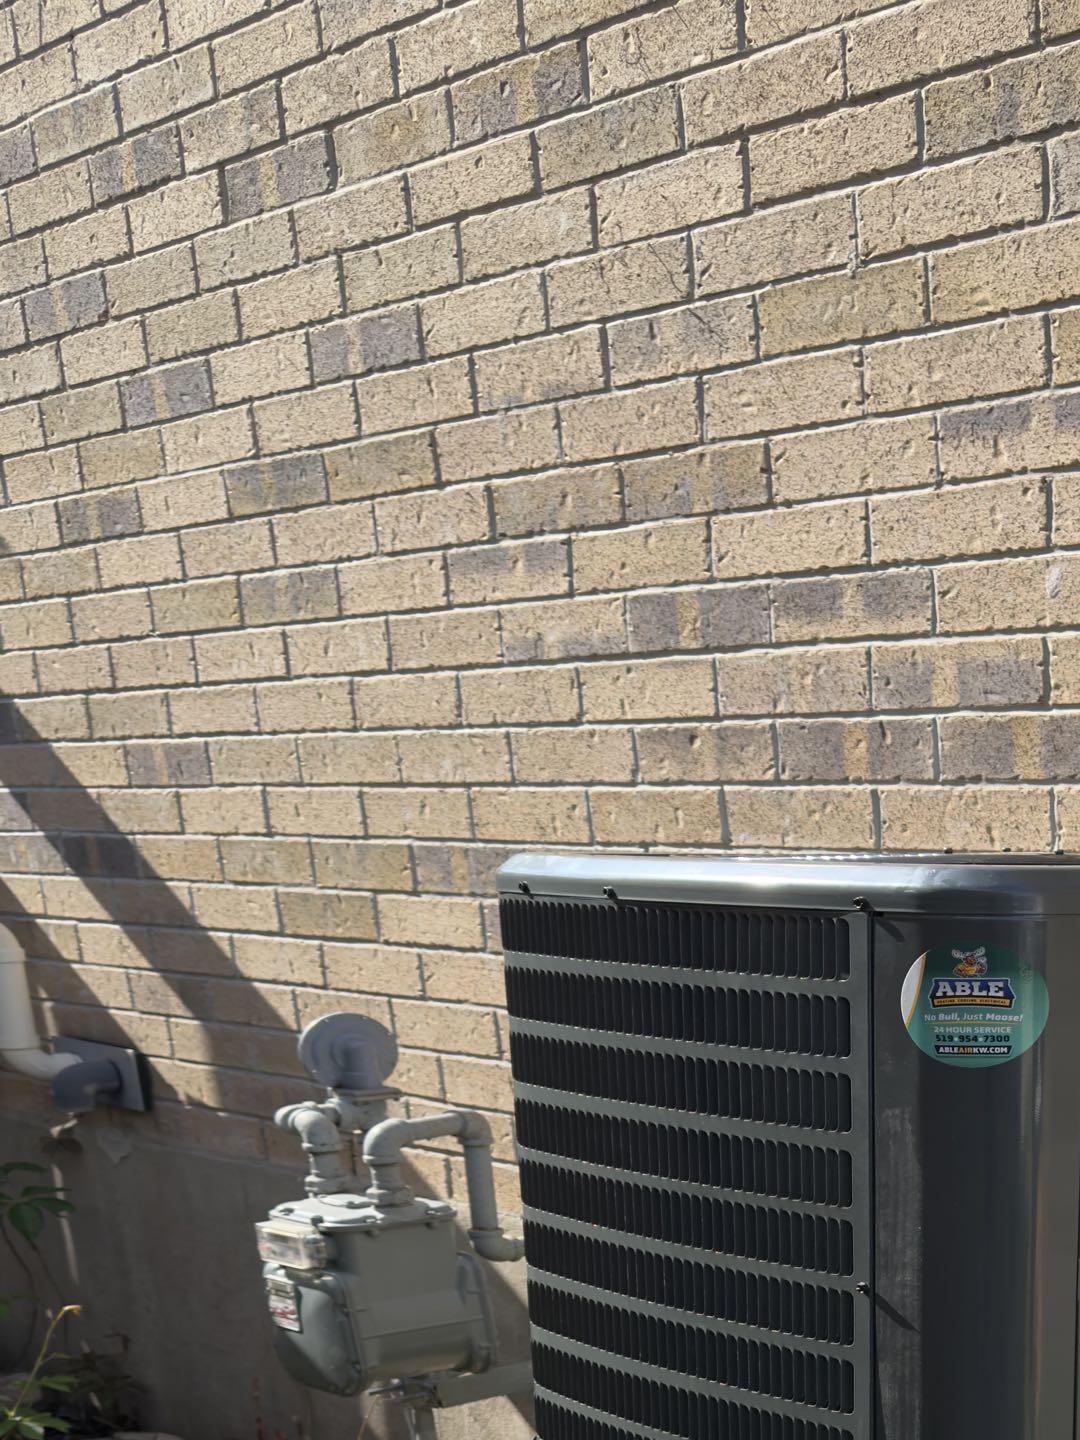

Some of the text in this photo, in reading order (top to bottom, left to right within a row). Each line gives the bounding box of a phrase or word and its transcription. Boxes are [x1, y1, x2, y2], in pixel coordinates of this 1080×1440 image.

[935, 981, 1004, 997] ABLE
[938, 1012, 960, 1021] Bull,
[962, 1012, 983, 1020] Just
[985, 1013, 1023, 1022] Moose!
[946, 1026, 972, 1034] HOUR
[974, 1026, 1012, 1034] SERVICE
[938, 1046, 1008, 1054] ABLEAIRKW.COM
